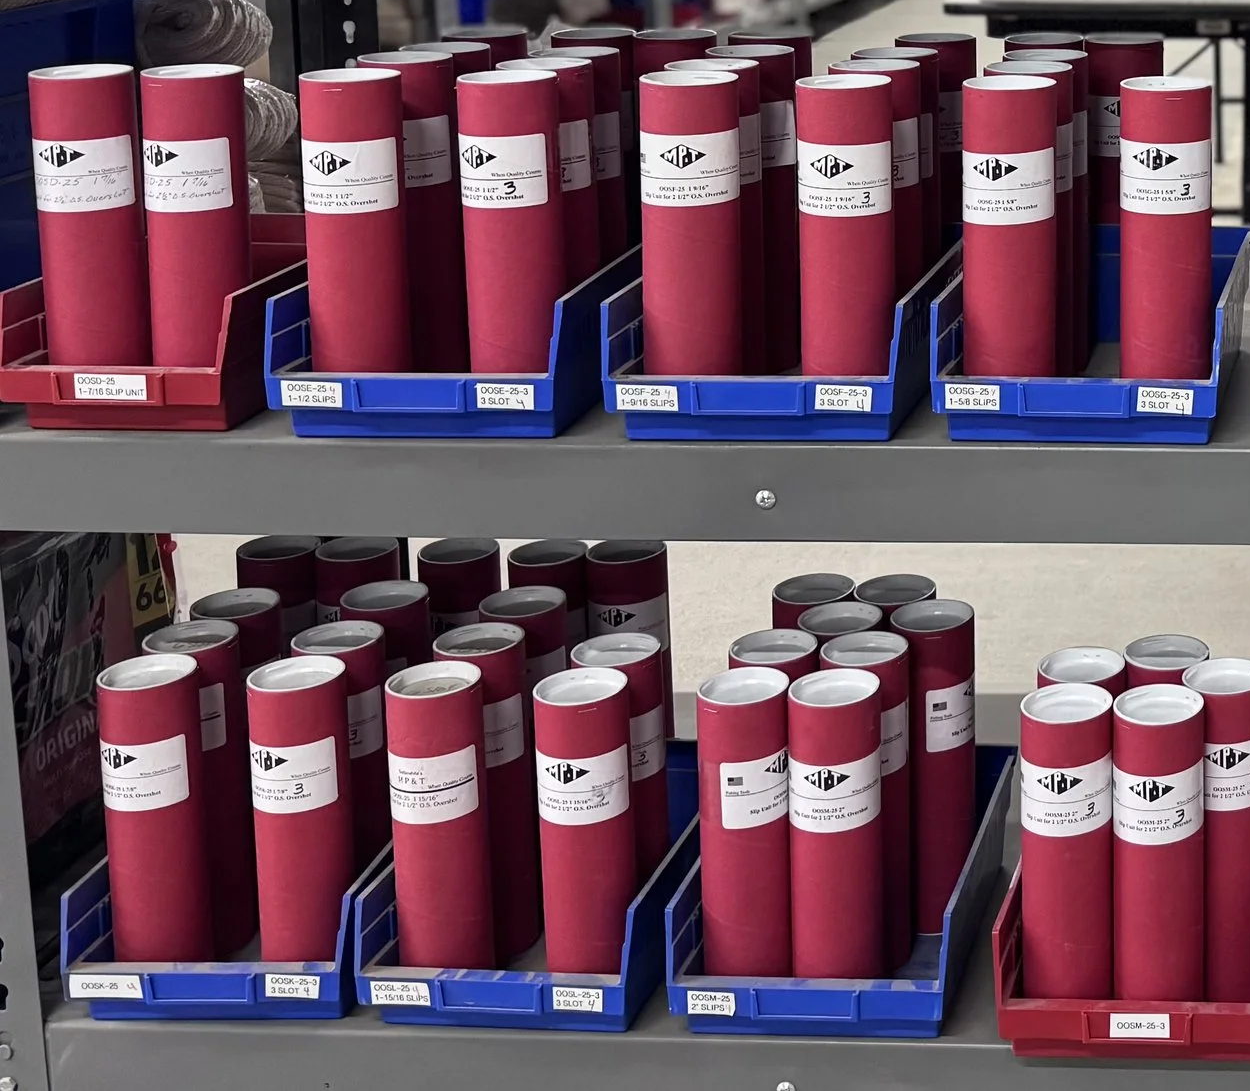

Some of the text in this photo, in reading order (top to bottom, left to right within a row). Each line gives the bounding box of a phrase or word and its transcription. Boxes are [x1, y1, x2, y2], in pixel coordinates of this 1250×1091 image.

[503, 181, 516, 195] 3
[1180, 183, 1190, 196] 3
[861, 191, 871, 204] 3
[77, 376, 115, 385] OOSD-25
[78, 387, 144, 396] 1-7/16 SLIP UNIT
[287, 383, 327, 393] OOSE-25
[480, 386, 529, 396] OOSE-25-3
[620, 387, 660, 396] OOSF-25
[820, 387, 867, 397] OOSF-25-3
[948, 386, 989, 396] OOSG-25
[288, 394, 336, 404] 1-1/2 SLIPS
[1141, 390, 1190, 401] OOSG-25-3
[488, 397, 510, 405] SLOT
[516, 398, 525, 409] 4
[621, 398, 675, 407] 1-9/16 SLIPS
[827, 398, 849, 407] SLOT
[949, 398, 997, 407] 1-5/8 SLIPS
[1148, 401, 1169, 409] SLOT
[37, 712, 99, 768] ORIGIN
[293, 783, 304, 795] 3
[1086, 802, 1095, 816] 3
[1173, 809, 1185, 825] 3
[81, 982, 119, 990] OOSK-25
[270, 977, 317, 986] OOSK-25-3
[373, 984, 410, 992] OOSL-25
[375, 993, 429, 1003] 1-15/16 SLIPS
[555, 989, 600, 999] OOSL-25-3
[691, 993, 731, 1002] OOSM-25
[563, 999, 583, 1007] SLOT
[700, 1003, 725, 1011] SLIPS
[1116, 1021, 1165, 1030] OOSM-25-3
